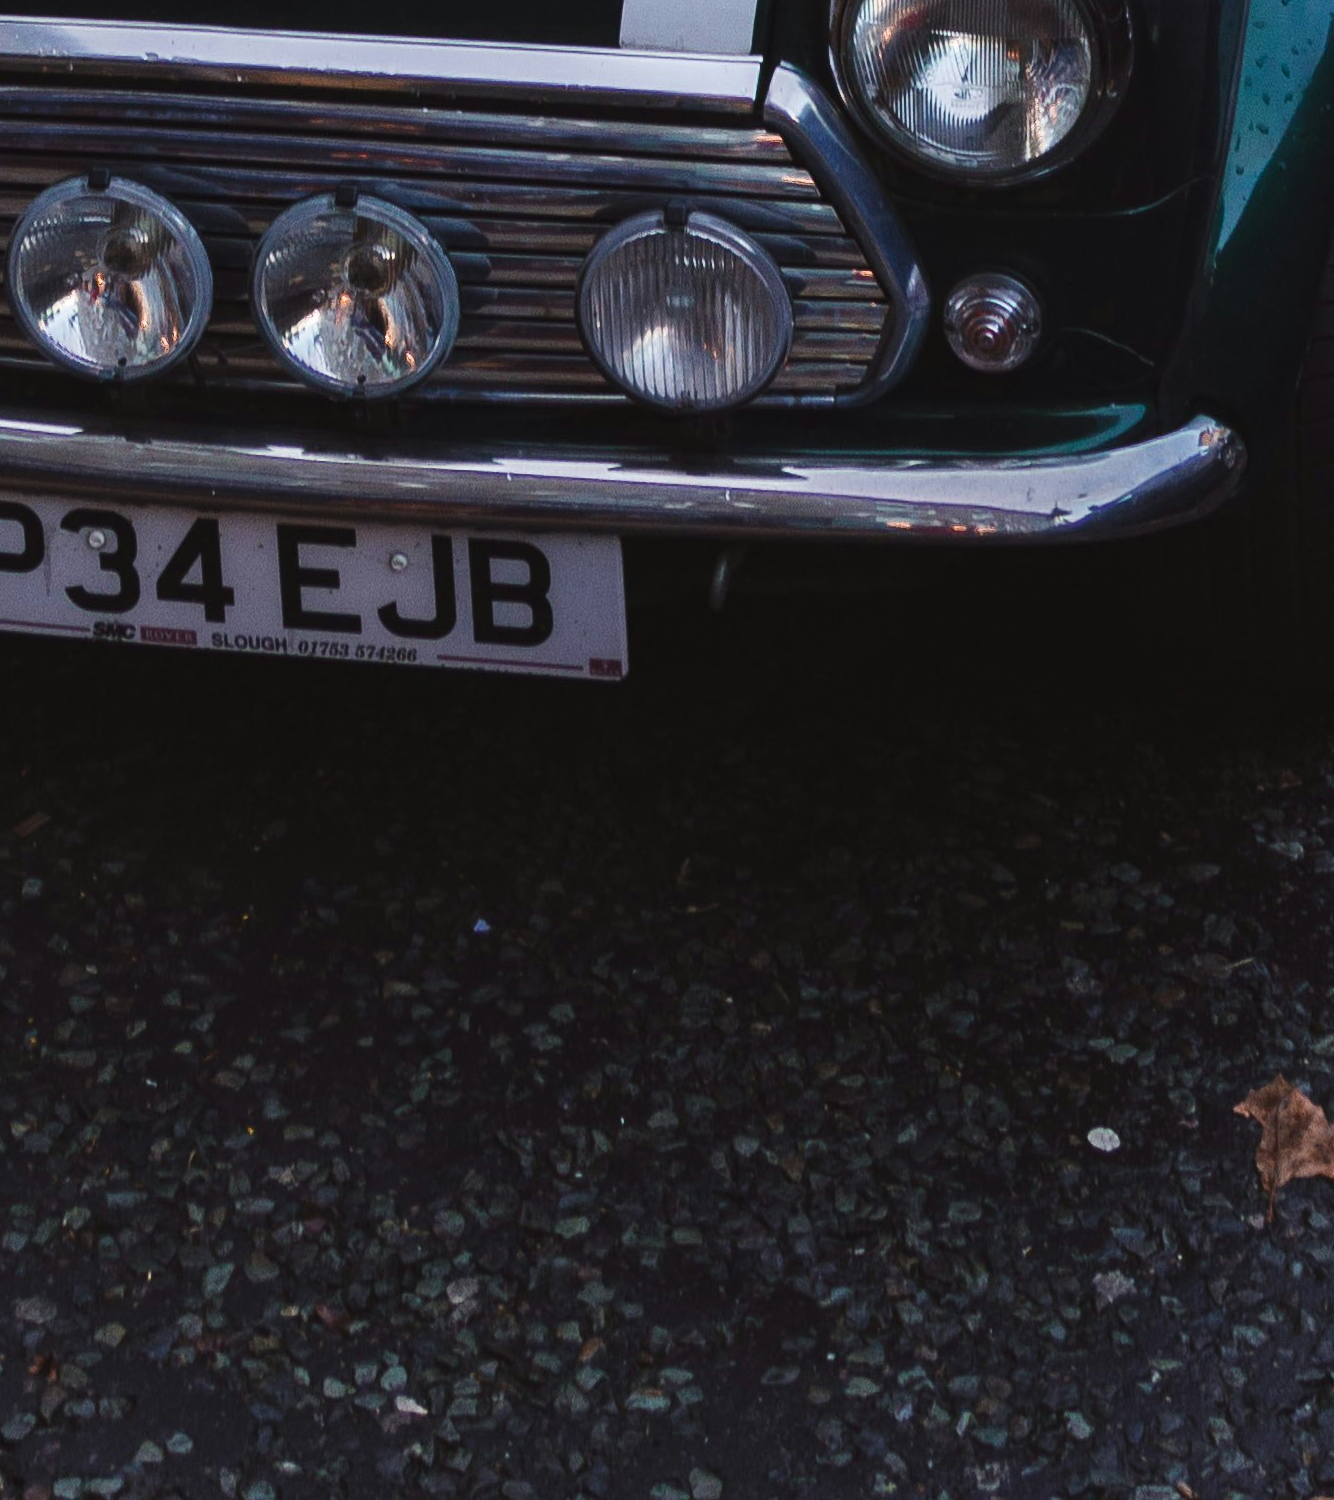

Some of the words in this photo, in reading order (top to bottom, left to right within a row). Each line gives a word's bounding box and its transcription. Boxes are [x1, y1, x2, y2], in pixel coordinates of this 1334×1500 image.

[276, 523, 554, 647] EJB
[92, 620, 137, 641] SMC
[145, 627, 195, 644] ROVER
[211, 632, 289, 653] SLOUGH
[297, 640, 350, 658] 01753
